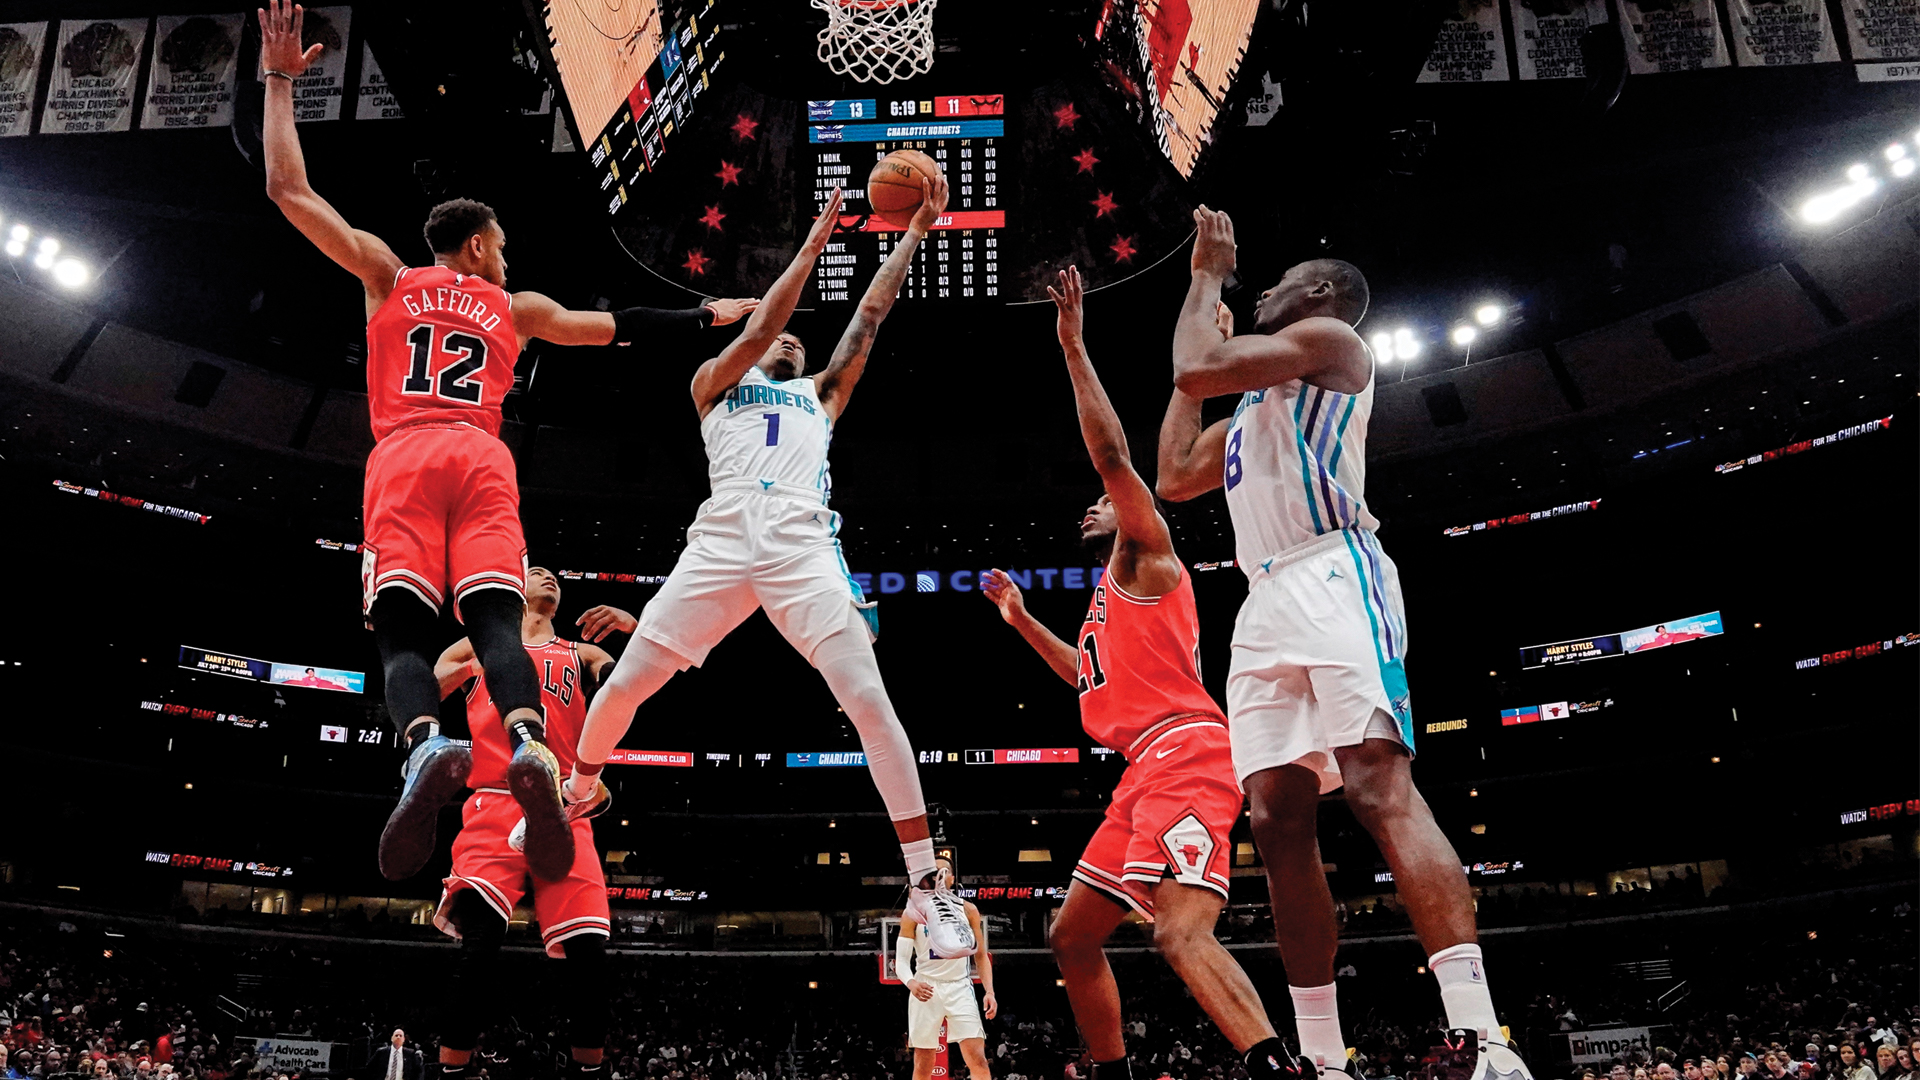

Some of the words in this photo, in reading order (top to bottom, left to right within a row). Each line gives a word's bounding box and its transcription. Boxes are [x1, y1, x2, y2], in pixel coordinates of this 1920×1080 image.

[1537, 18, 1585, 28] CHICAGO
[1433, 41, 1486, 51] ESTERN
[1535, 38, 1580, 48] WESTE
[1429, 51, 1496, 61] ONFERENCE
[1427, 61, 1492, 71] CHAMPIONS
[171, 73, 215, 83] CHICAGO
[1440, 71, 1482, 81] 2012-13
[71, 79, 115, 88] CHICAGO
[155, 82, 225, 94] BLACKHAWKS
[56, 88, 126, 99] BLACKHAWKS
[188, 93, 230, 104] DIVISION
[302, 87, 342, 98] DIVISION
[48, 100, 86, 110] NORRIS
[87, 99, 130, 110] DIVISION
[158, 104, 217, 115] CHAMPIONS
[850, 102, 862, 118] 13
[890, 100, 916, 116] 6:19
[948, 99, 959, 114] 11
[56, 110, 116, 121] CHAMPIONS
[164, 115, 208, 126] 1992-93
[65, 121, 105, 131] 1990-91
[886, 126, 927, 137] CHARLOTTE
[928, 125, 961, 136] HORNETS
[903, 142, 912, 150] PTS
[823, 154, 840, 162] MONK
[937, 150, 946, 159] 0/0
[961, 149, 971, 158] 0/0
[985, 148, 995, 157] 0/0
[818, 167, 821, 175] 8
[824, 166, 850, 175] BIYOMBO
[961, 161, 971, 170] 0/0
[986, 160, 995, 169] 0/0
[816, 179, 822, 187] 11
[824, 178, 846, 188] MARTIN
[962, 174, 972, 182] 0/0
[986, 173, 996, 182] 0/0
[815, 191, 822, 200] 25
[824, 189, 864, 200] WINGTON
[962, 186, 972, 195] 0/0
[986, 185, 996, 194] 2/2
[963, 198, 971, 207] 1/1
[986, 197, 996, 206] 0/0
[933, 216, 953, 226] ULLS
[825, 243, 845, 252] WHITE
[921, 241, 925, 249] 0
[938, 240, 948, 249] 0/0
[963, 239, 973, 248] 0/0
[986, 239, 996, 247] 0/0
[821, 256, 824, 265] 3
[827, 255, 856, 264] HARRISON
[922, 253, 925, 261] 0
[938, 252, 948, 261] 0/0
[963, 251, 973, 260] 0/0
[987, 251, 997, 259] 0/0
[818, 268, 825, 277] 12
[827, 267, 853, 276] GAFFORD
[963, 263, 973, 272] 0/0
[987, 263, 997, 271] 0/0
[818, 280, 825, 289] 21
[827, 280, 847, 288] YOUNG
[922, 277, 926, 285] 2
[939, 276, 948, 285] 0/3
[963, 275, 972, 284] 0/1
[987, 275, 997, 284] 0/0
[822, 292, 825, 300] 8
[828, 292, 848, 300] LAVINE
[964, 288, 973, 296] 0/0
[987, 287, 997, 296] 0/0
[402, 287, 501, 332] GAFFORD
[401, 323, 489, 406] 12
[725, 384, 818, 416] HORNETS
[763, 413, 780, 447] 1
[1747, 454, 1762, 465] YOUR
[1813, 439, 1825, 447] FOR
[1826, 433, 1837, 443] THE
[1838, 419, 1880, 441] CHICAGO
[1226, 427, 1243, 492] 8
[84, 488, 99, 498] YOUR
[143, 501, 154, 511] FOR
[154, 504, 165, 513] THE
[165, 506, 199, 521] CHICAGO
[1473, 522, 1486, 531] YOUR
[1530, 512, 1541, 521] FOR
[1542, 510, 1552, 518] THE
[1552, 501, 1589, 517] CHICAGO
[636, 575, 646, 583] FOR
[950, 567, 1106, 592] CNTE
[1546, 644, 1570, 656] HARRY
[1571, 641, 1594, 652] STYLES
[1796, 657, 1820, 670] WATCH
[1855, 641, 1882, 659] GAME
[1883, 640, 1893, 650] ON
[204, 653, 226, 665] HARRY
[227, 657, 248, 669] STYLES
[141, 700, 163, 712] WATCH
[191, 708, 217, 721] GAME
[1426, 718, 1468, 734] REBOUNDS
[358, 729, 383, 744] 7:21
[627, 753, 668, 763] CHAMPIONS
[668, 755, 687, 764] CLUB
[706, 752, 731, 761] TIMEOUTS
[755, 752, 771, 761] FOULS
[818, 753, 864, 765] CHARLOTTE
[919, 750, 943, 764] 6:19
[975, 751, 986, 763] 11
[1007, 749, 1041, 762] CHICAGO
[1841, 810, 1867, 825] WATCH
[145, 851, 170, 864] WATCH
[171, 853, 203, 868] EVERY
[203, 857, 233, 872] GAME
[233, 861, 243, 872] ON
[625, 887, 651, 900] GAME
[652, 890, 661, 899] ON
[978, 887, 1006, 900] EVERY
[1007, 886, 1034, 899] GAME
[1034, 888, 1044, 898] ON
[274, 1044, 320, 1056] Advocate
[1585, 1034, 1648, 1058] impact
[305, 1058, 327, 1069] Care
